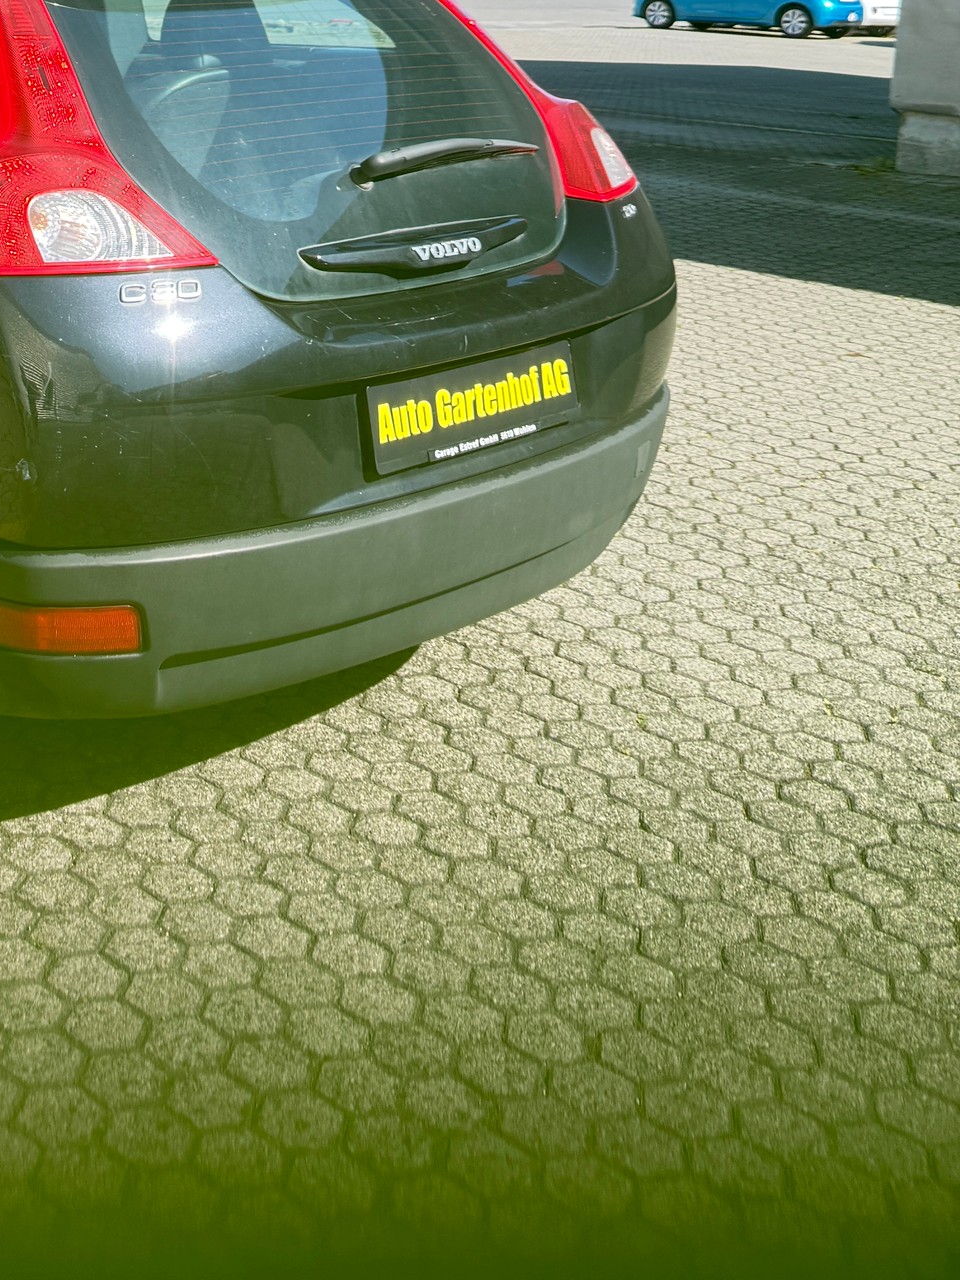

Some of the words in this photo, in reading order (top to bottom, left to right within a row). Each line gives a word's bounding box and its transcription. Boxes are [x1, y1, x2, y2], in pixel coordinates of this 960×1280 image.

[411, 237, 482, 261] VOLVO
[119, 279, 202, 304] C30
[377, 399, 434, 444] Auto
[435, 365, 542, 428] Gartenhof
[541, 358, 572, 399] AG
